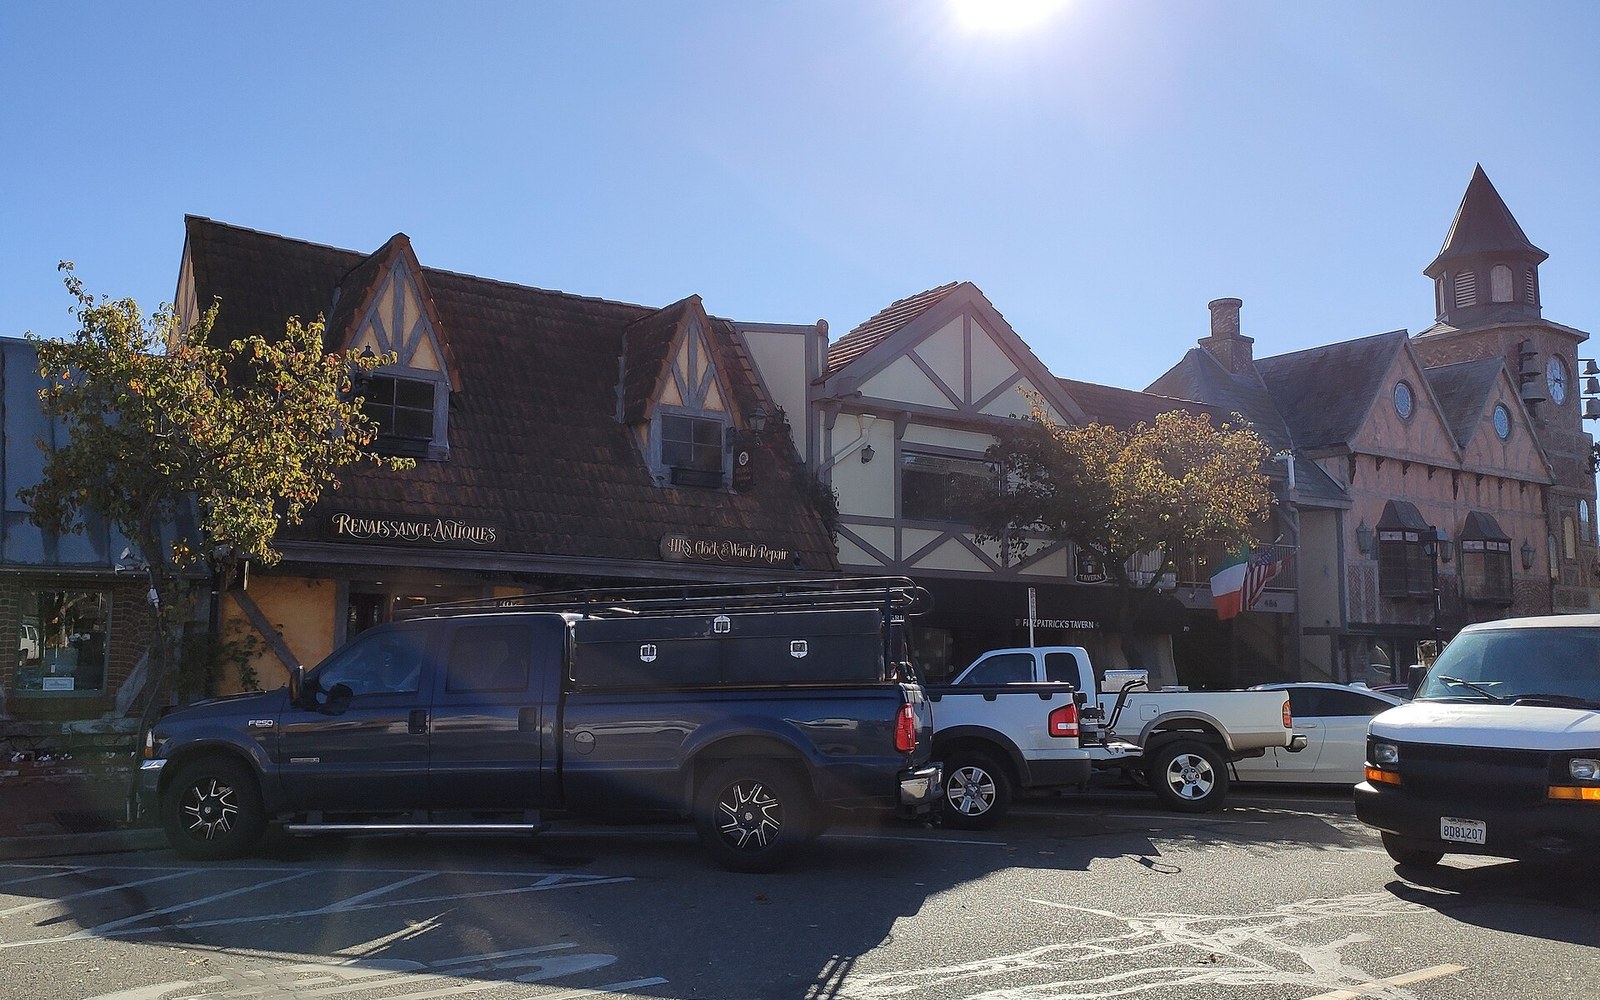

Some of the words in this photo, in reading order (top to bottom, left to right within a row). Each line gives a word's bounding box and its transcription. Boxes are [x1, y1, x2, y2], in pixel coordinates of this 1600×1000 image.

[332, 513, 431, 541] RENAISSANCE
[431, 518, 496, 544] ANTIQUES
[695, 540, 721, 560] Clock
[720, 542, 730, 556] &
[729, 542, 757, 561] Watch
[757, 543, 789, 564] Repair
[1079, 573, 1102, 581] TAVERN
[1022, 618, 1070, 629] FIZPATRICK'S
[1070, 620, 1094, 629] TAVERN
